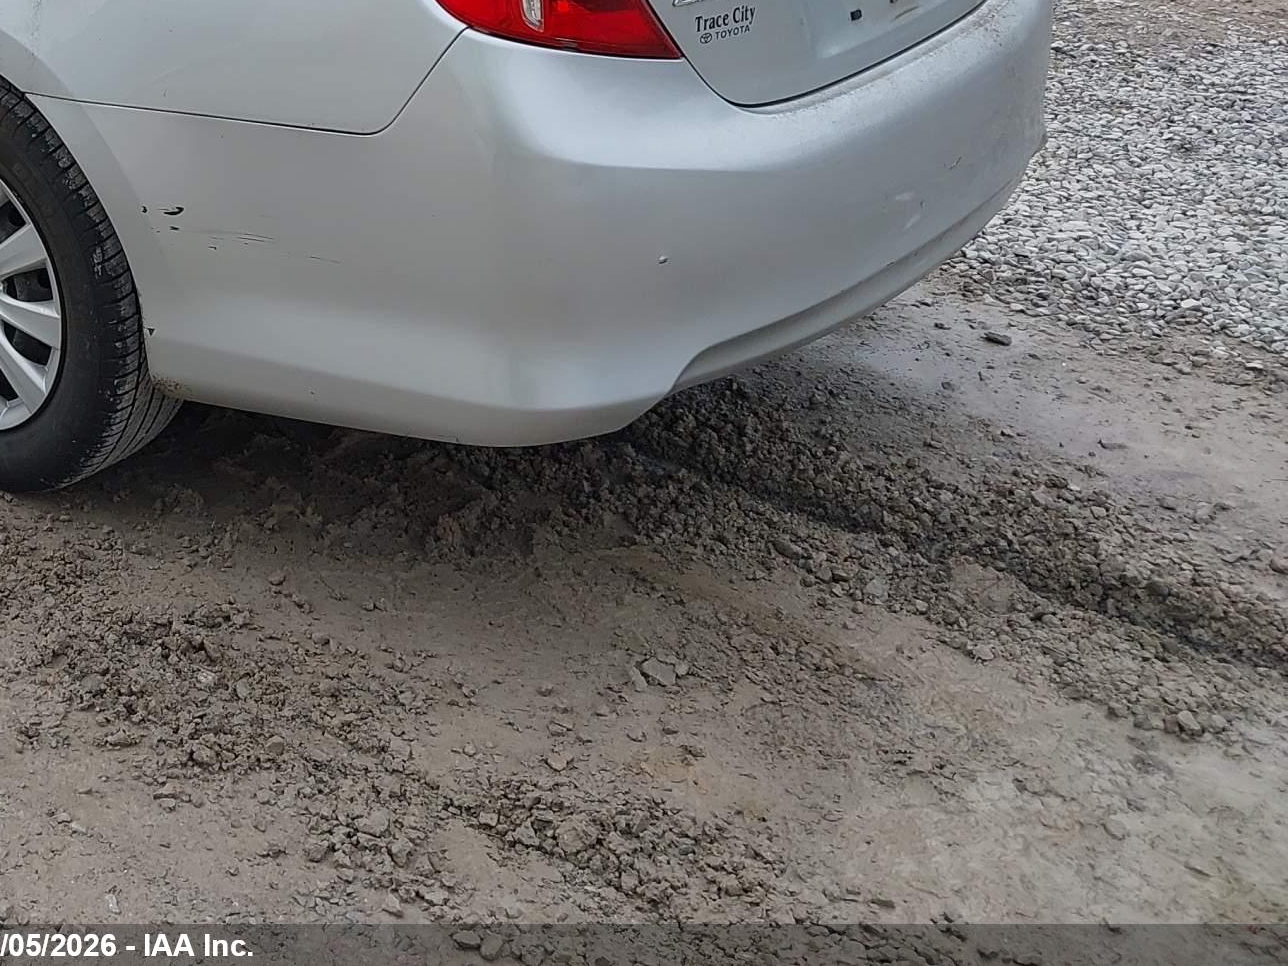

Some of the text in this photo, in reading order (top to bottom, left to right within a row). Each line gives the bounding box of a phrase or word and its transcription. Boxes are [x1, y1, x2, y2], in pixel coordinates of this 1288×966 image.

[695, 5, 756, 33] Trace City
[715, 25, 750, 40] TOYOTA
